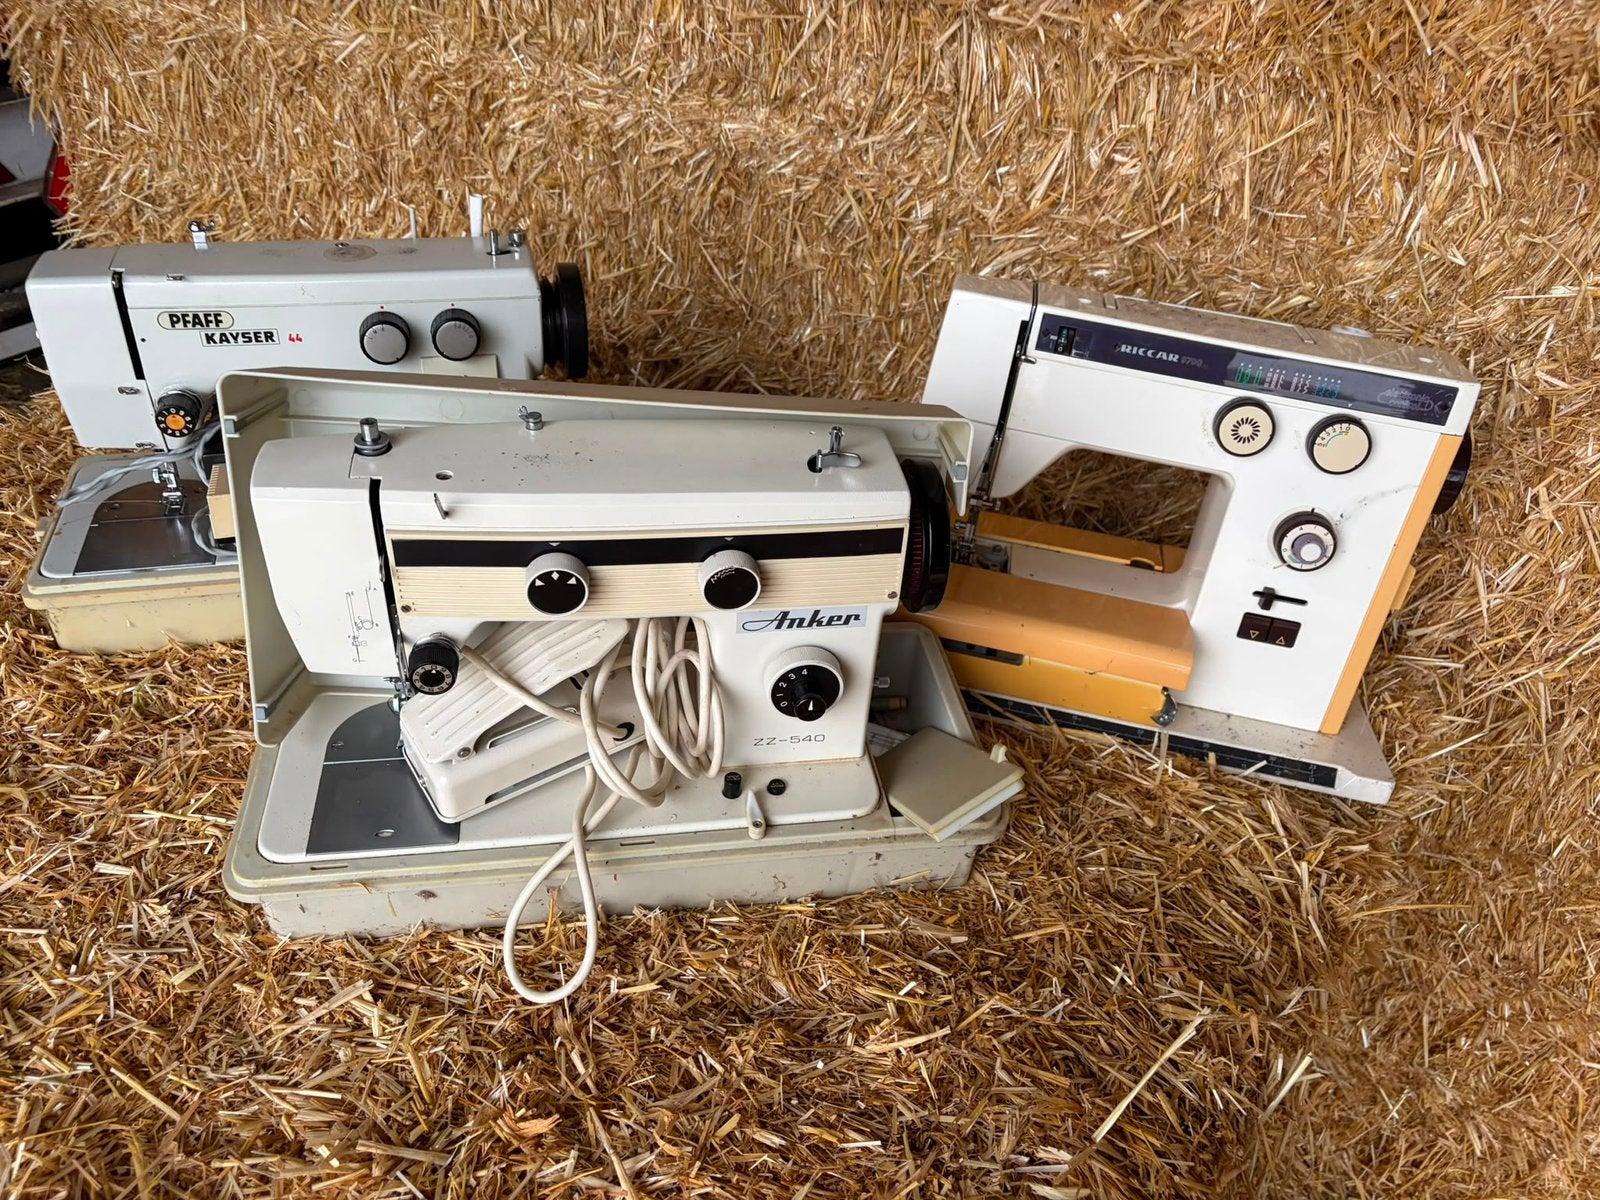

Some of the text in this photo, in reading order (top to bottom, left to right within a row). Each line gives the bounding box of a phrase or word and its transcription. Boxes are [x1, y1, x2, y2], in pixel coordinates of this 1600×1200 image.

[168, 312, 224, 329] PFAFF
[204, 331, 303, 345] KAYSER 44
[1120, 343, 1180, 363] RICCAR
[742, 609, 861, 631] Anker
[753, 733, 826, 747] ZZ-540
